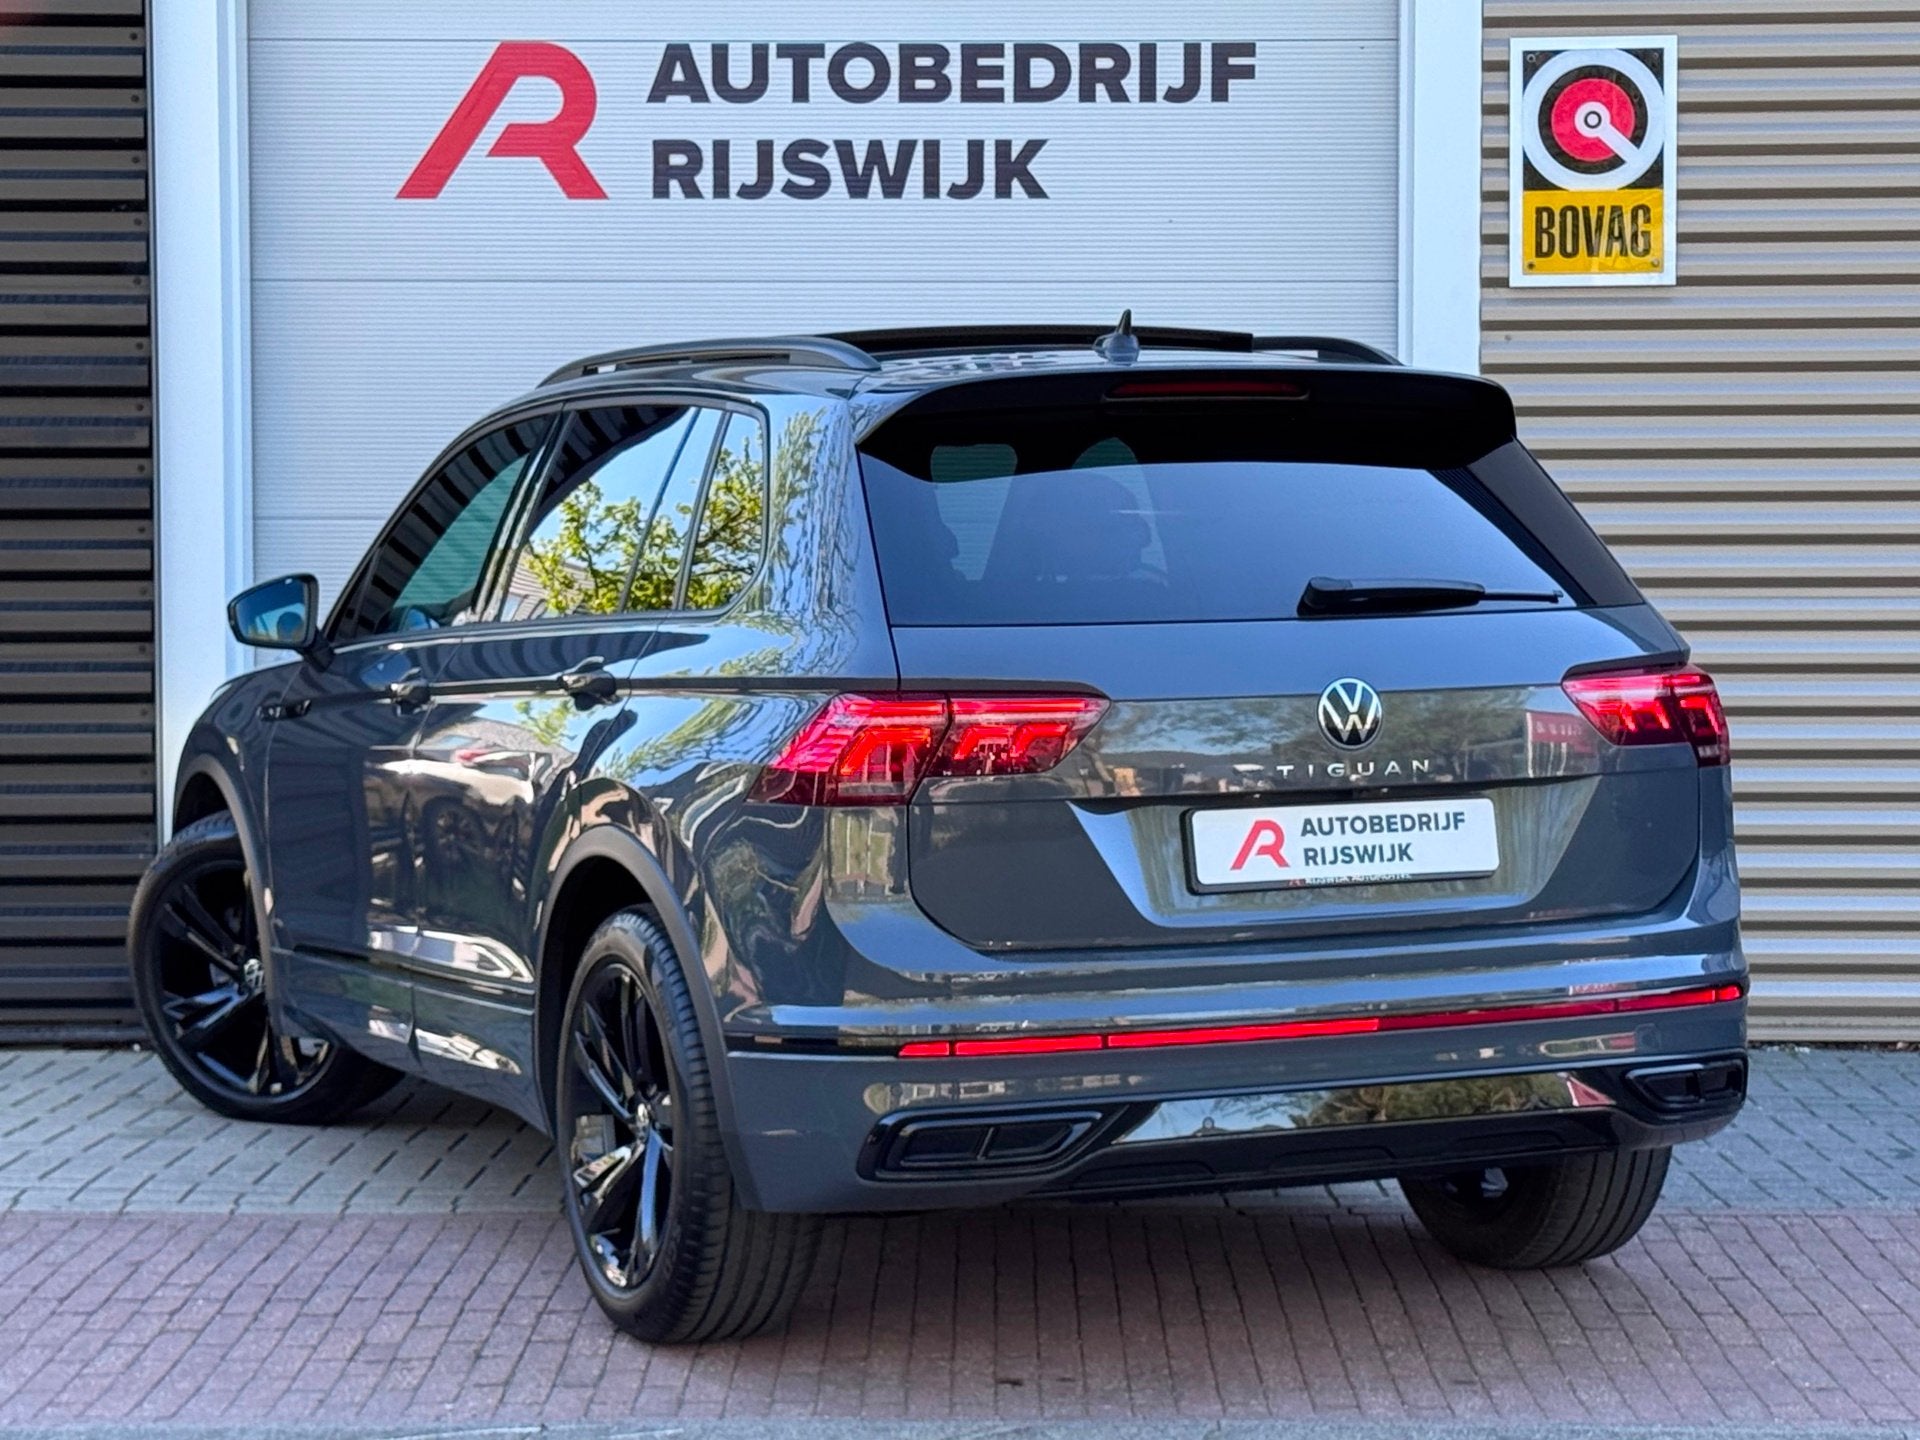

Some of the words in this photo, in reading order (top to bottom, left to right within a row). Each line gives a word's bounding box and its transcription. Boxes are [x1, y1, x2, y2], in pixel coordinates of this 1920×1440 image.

[646, 41, 1257, 104] AUTOBEDRIJF
[652, 138, 1050, 200] RIJSWIJK
[1534, 204, 1652, 259] BOVAG
[1275, 759, 1430, 779] TIGUAN
[1300, 811, 1466, 837] AUTOBEDRIJF
[1303, 842, 1414, 867] RIJSWIJK
